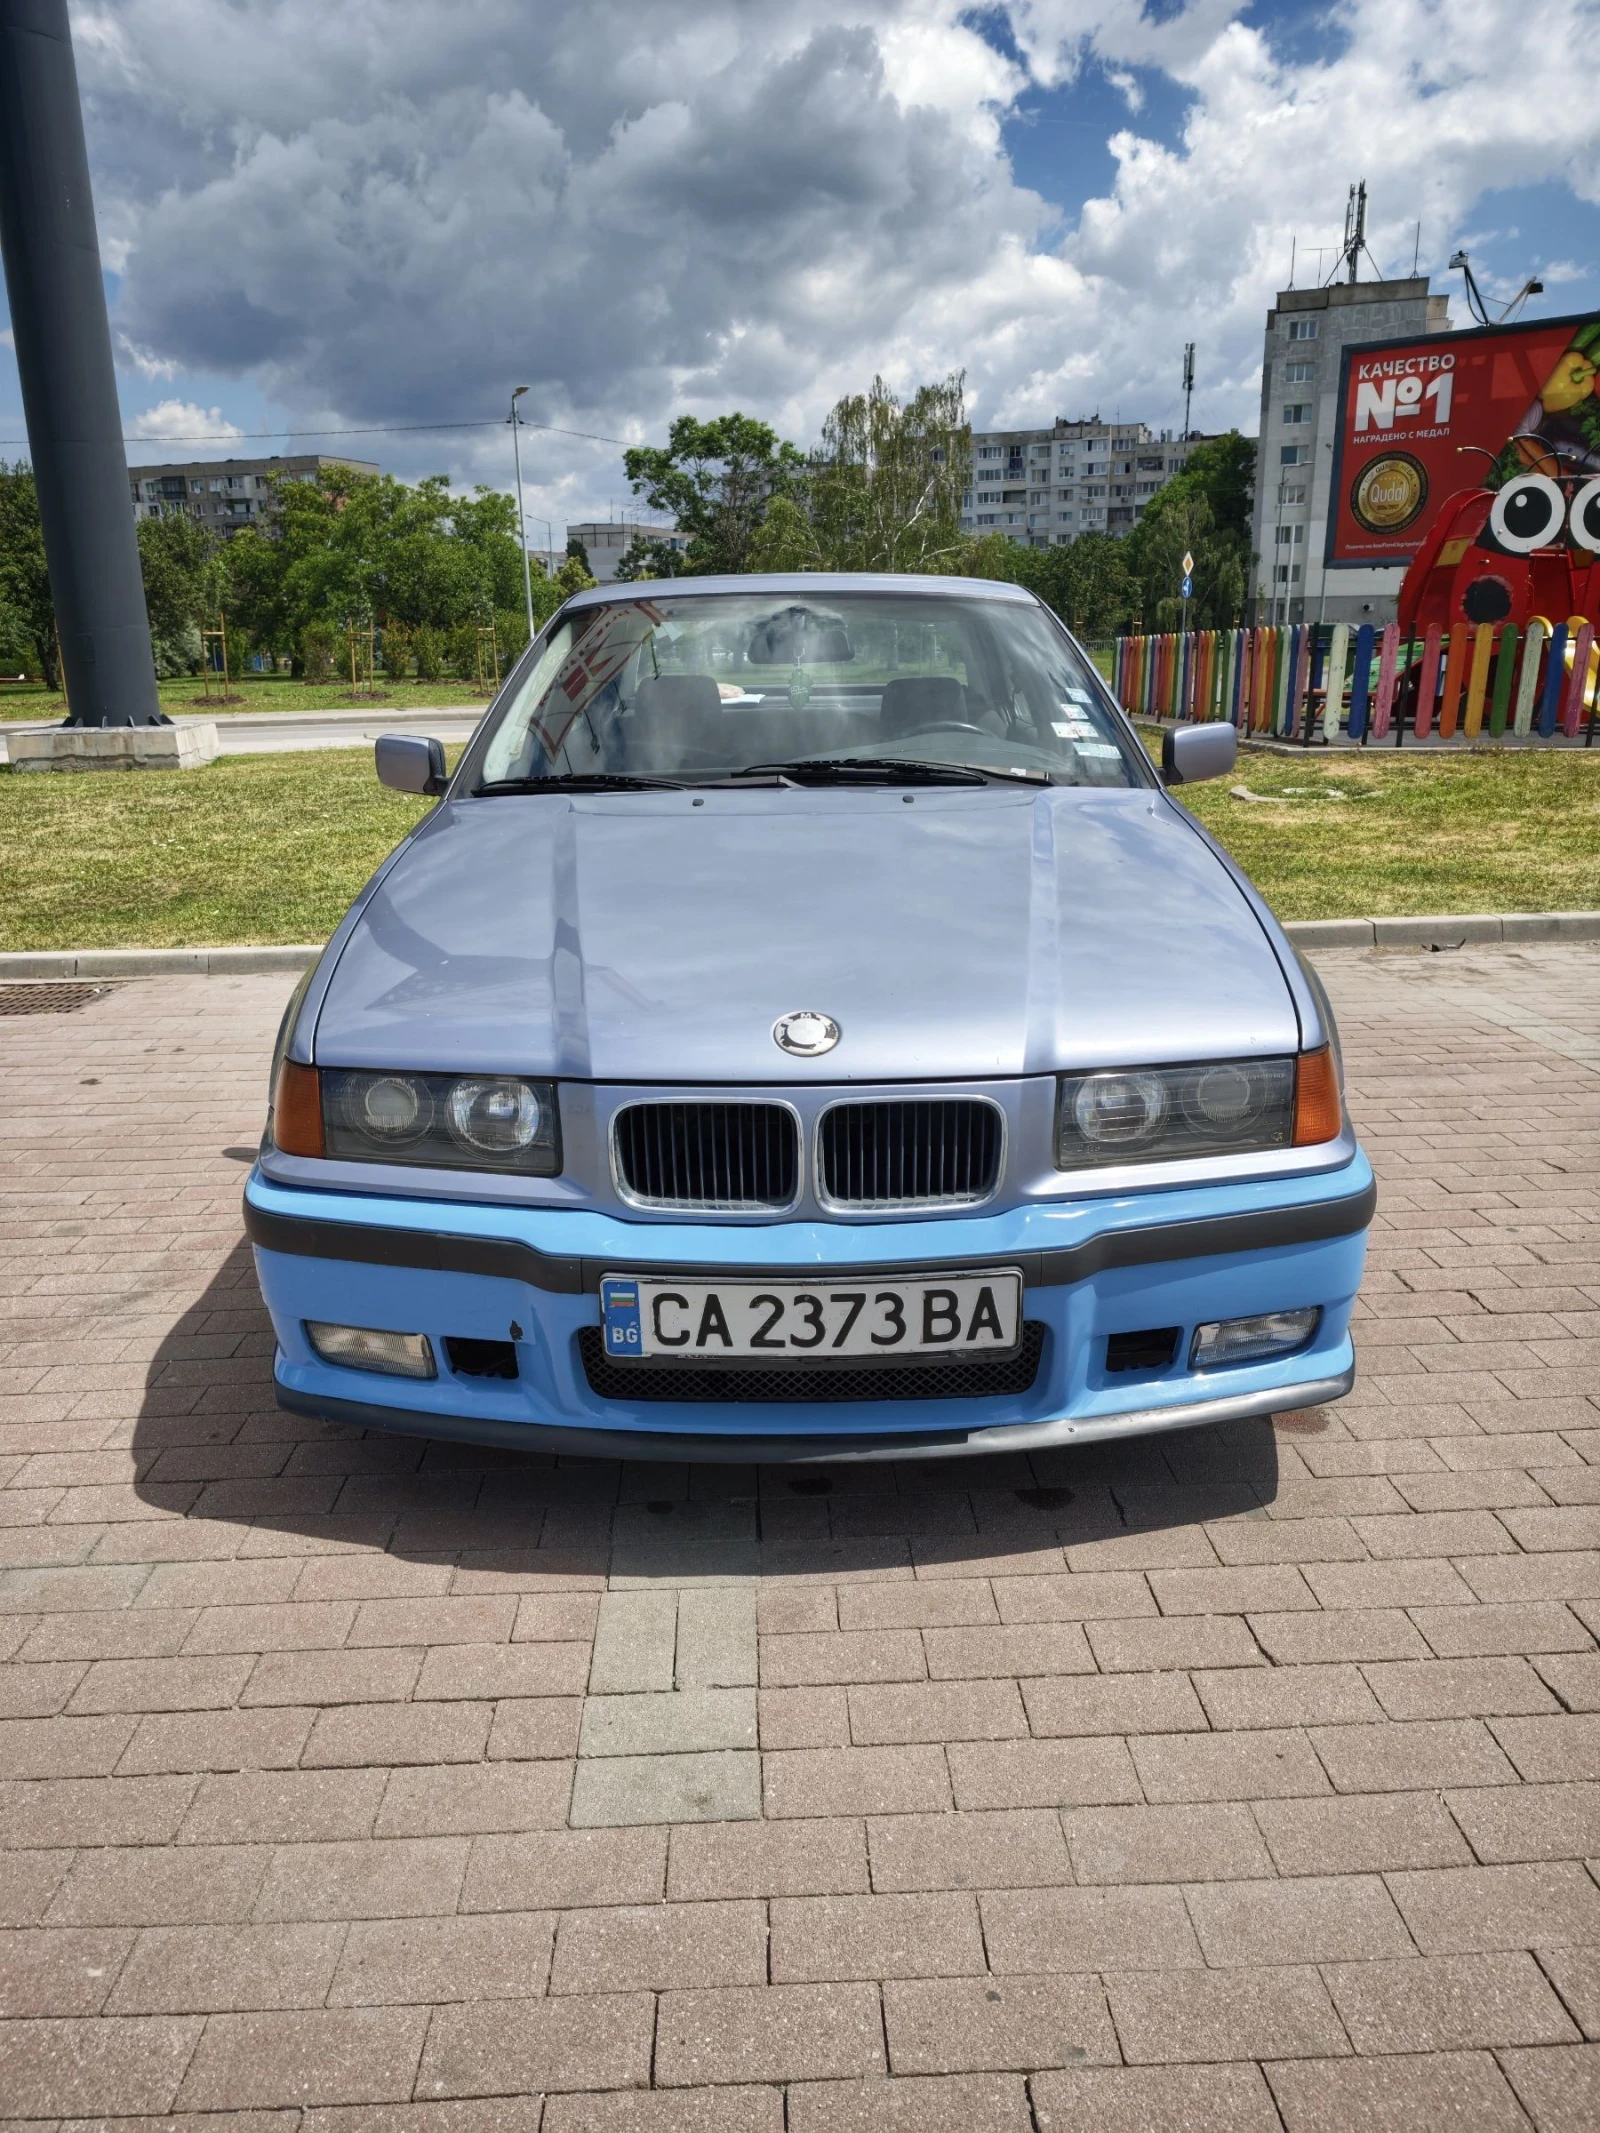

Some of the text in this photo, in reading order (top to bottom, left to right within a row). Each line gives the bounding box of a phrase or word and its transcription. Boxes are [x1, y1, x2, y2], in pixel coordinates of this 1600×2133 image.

[1359, 354, 1455, 379] КАЧЕСТВО
[1354, 428, 1450, 444] НАГРАДЕНО С МЕДАЛ
[1371, 481, 1407, 503] Qudal
[652, 1286, 1004, 1348] CA 2373 BA
[612, 1327, 638, 1344] BG
